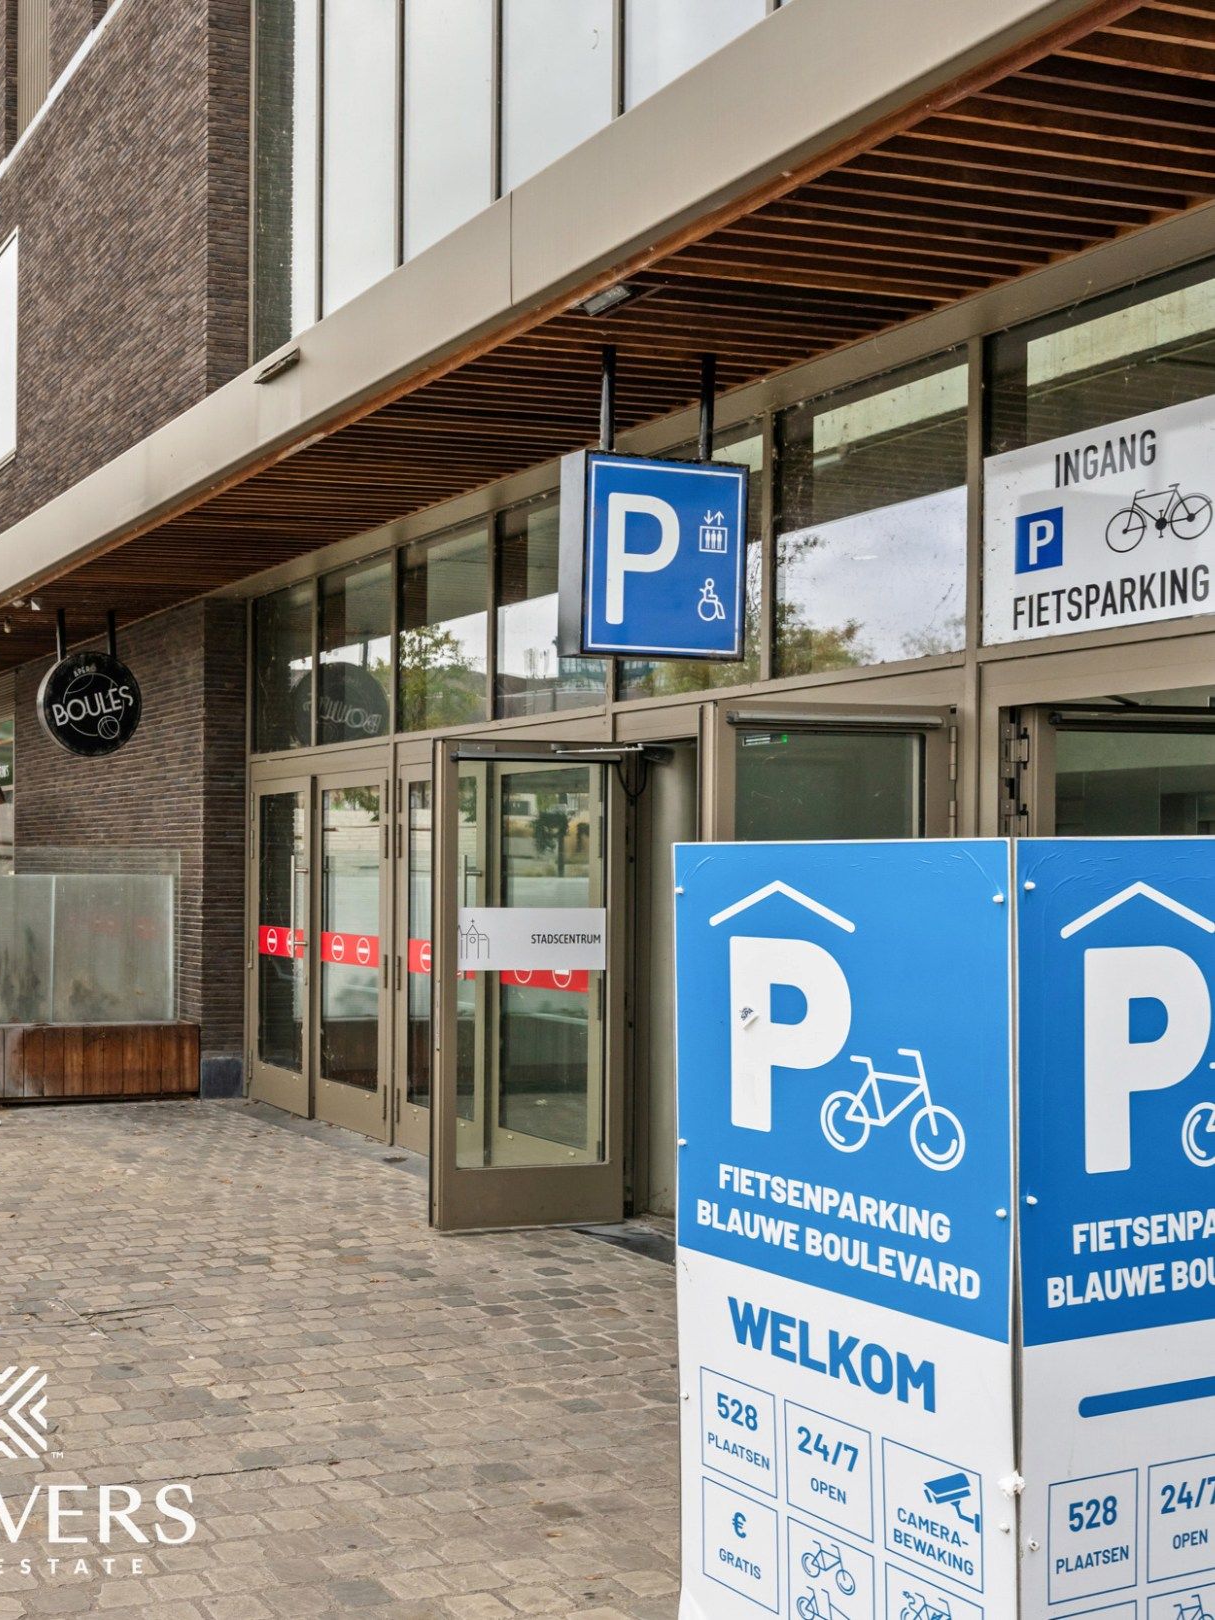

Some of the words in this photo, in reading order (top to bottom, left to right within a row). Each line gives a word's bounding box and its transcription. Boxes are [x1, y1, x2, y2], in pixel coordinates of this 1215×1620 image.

[1054, 429, 1157, 489] INGANG
[604, 491, 681, 626] P
[1028, 518, 1055, 566] P
[1013, 563, 1211, 632] FIETSPARKING
[51, 685, 134, 727] BOULES
[530, 933, 601, 945] STADSCENTRUM
[729, 936, 852, 1133] P
[1084, 945, 1212, 1174] P
[719, 1162, 951, 1244] FIETSENPARKING
[696, 1199, 800, 1252] BLAUWE
[804, 1220, 981, 1300] BOULEVARD
[1046, 1262, 1166, 1309] BLAUWE
[727, 1295, 937, 1414] WELKOM
[716, 1391, 758, 1432] 528
[707, 1431, 771, 1471] PLAATSEN
[797, 1425, 860, 1473] 24/7
[810, 1476, 847, 1505] OPEN
[1068, 1494, 1118, 1533] 528
[732, 1511, 747, 1539] €
[897, 1506, 969, 1548] CAMERA-
[1172, 1528, 1209, 1550] OPEN
[718, 1547, 762, 1580] GRATIS
[893, 1527, 974, 1576] BEWAKING
[1055, 1544, 1130, 1575] PLAATSEN
